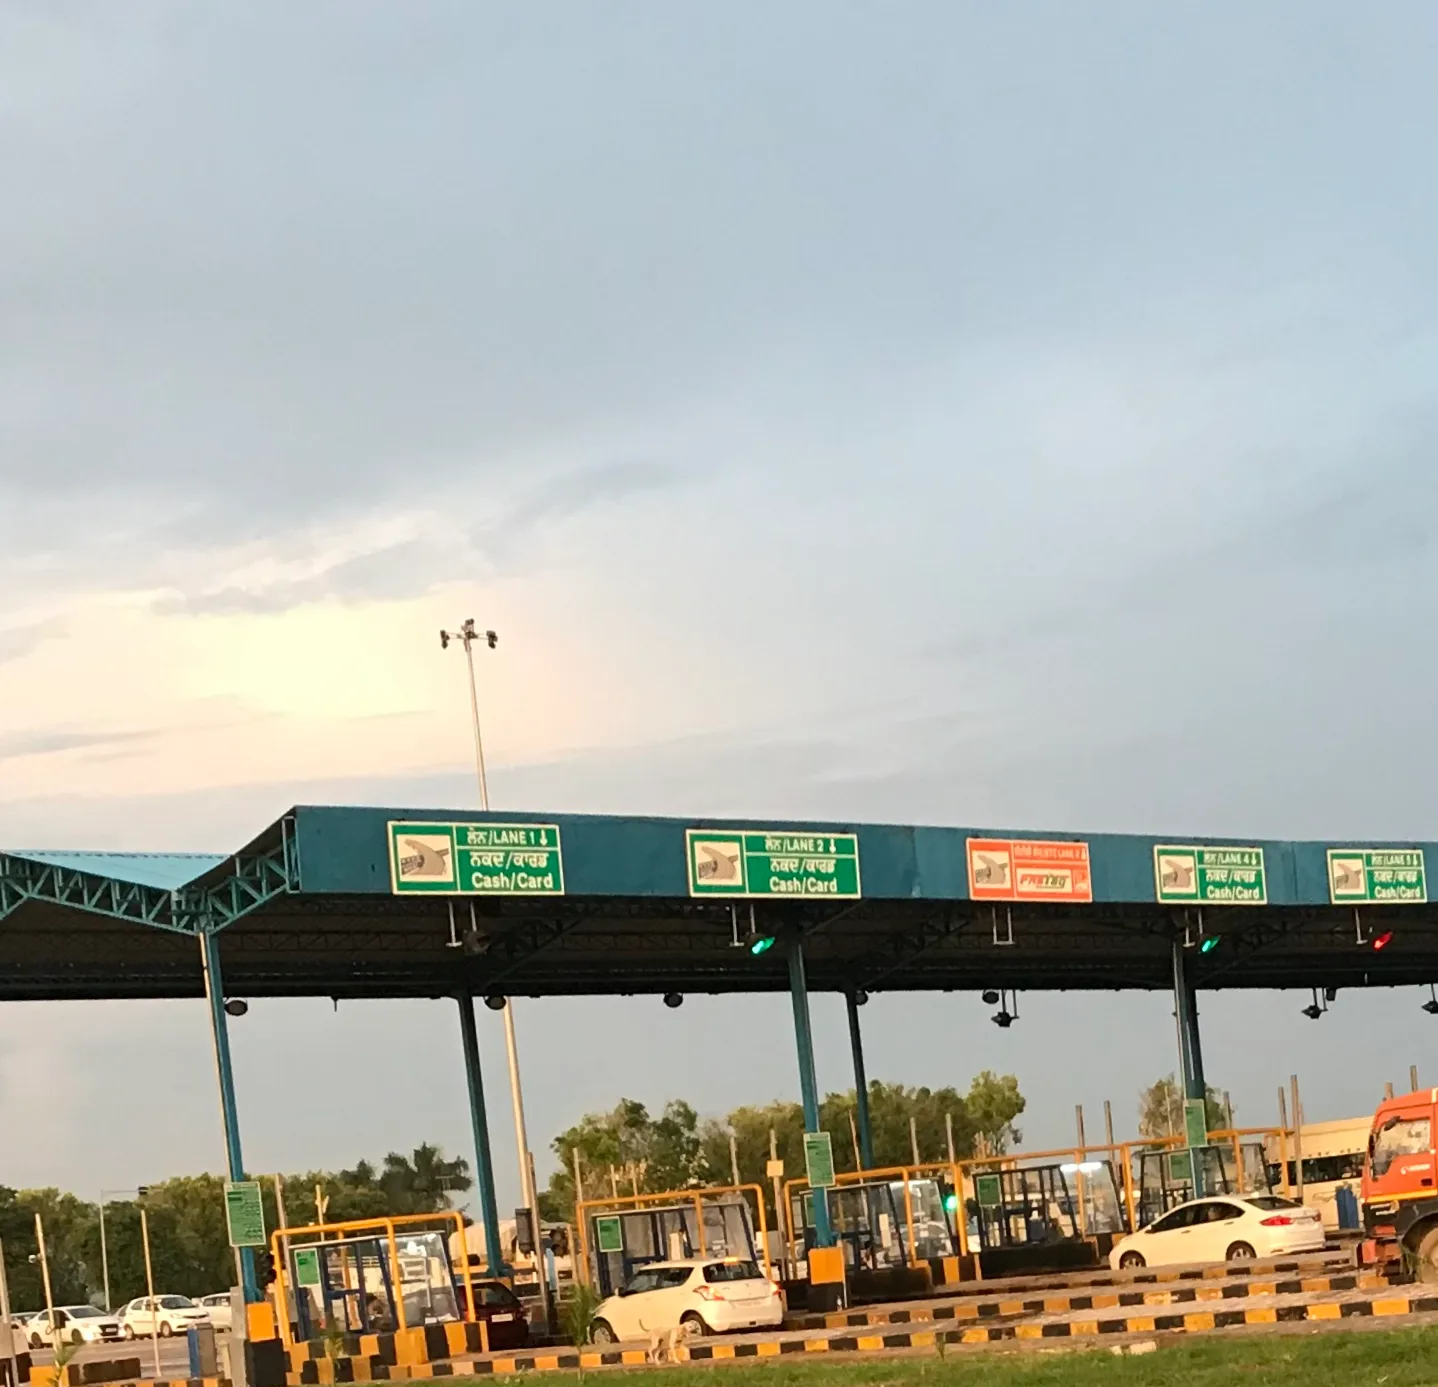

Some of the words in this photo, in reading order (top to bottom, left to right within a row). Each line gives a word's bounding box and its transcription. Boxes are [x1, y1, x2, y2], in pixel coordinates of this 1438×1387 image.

[816, 839, 824, 853] 2
[471, 872, 554, 890] Cash/Card
[769, 876, 838, 894] Cash/Card
